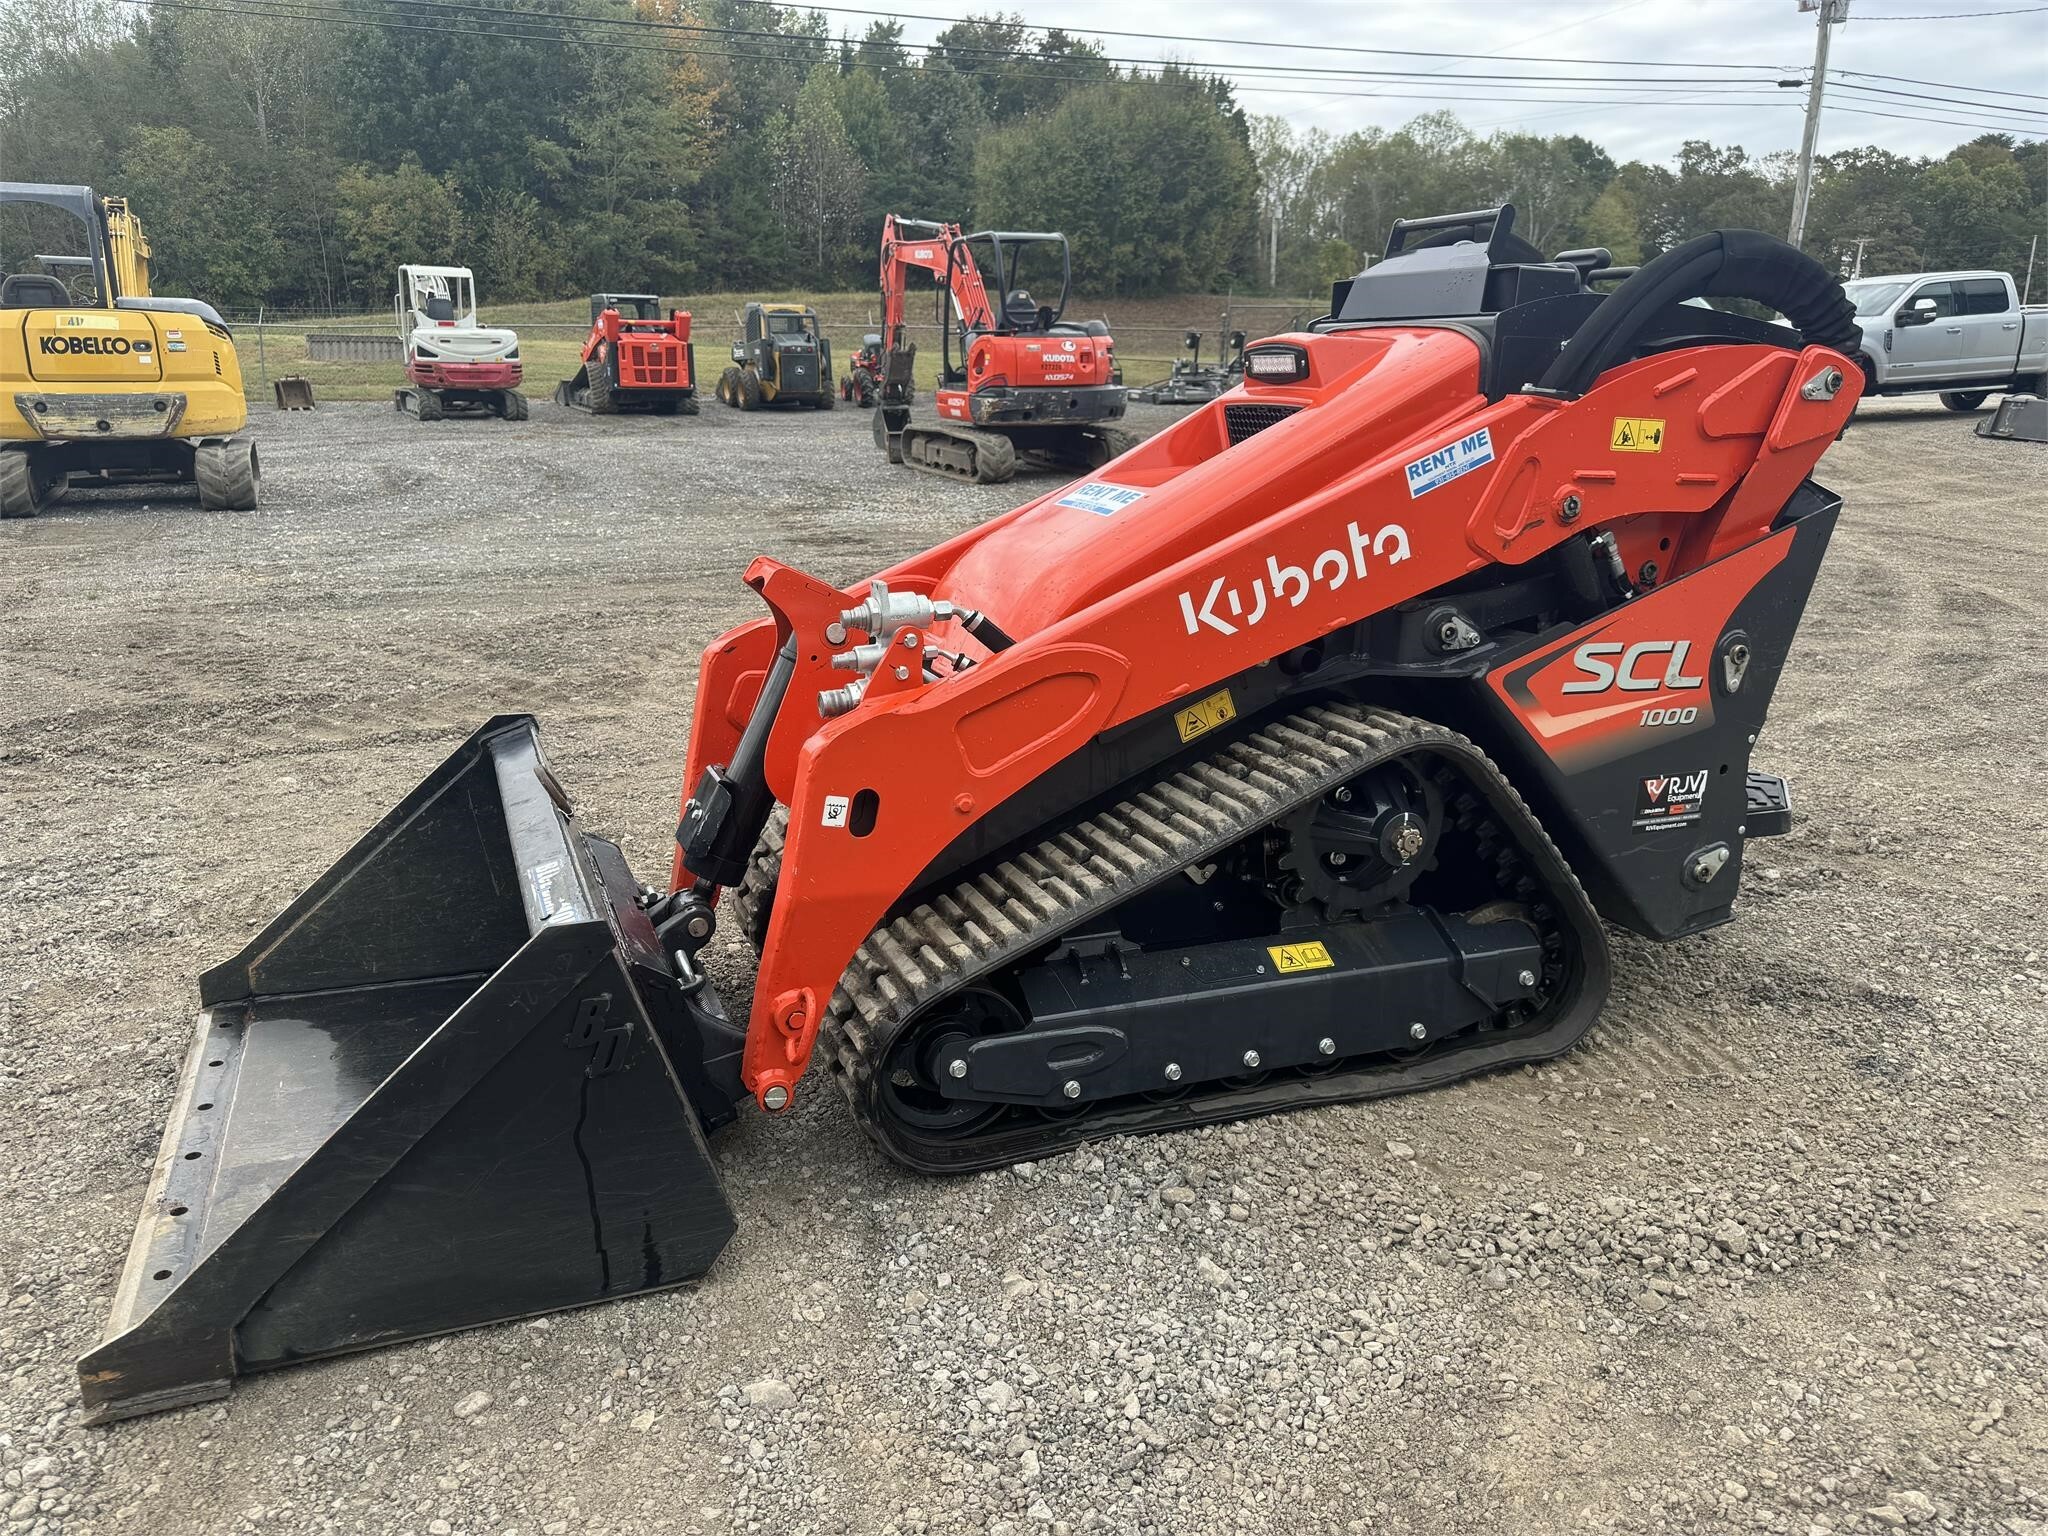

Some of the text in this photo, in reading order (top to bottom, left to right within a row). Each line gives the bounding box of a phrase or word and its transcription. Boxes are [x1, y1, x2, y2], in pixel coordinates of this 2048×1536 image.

[40, 336, 131, 355] KOBELCO
[1043, 354, 1076, 363] KUBOTA
[1407, 445, 1456, 481] RENT
[1461, 430, 1489, 456] ME
[1075, 484, 1119, 498] RENT
[1109, 490, 1142, 505] ME
[1178, 521, 1411, 636] Kubota
[1561, 640, 1703, 695] SCL
[1639, 707, 1698, 727] 1000
[1668, 774, 1702, 795] RJV
[1667, 793, 1701, 803] Equipment
